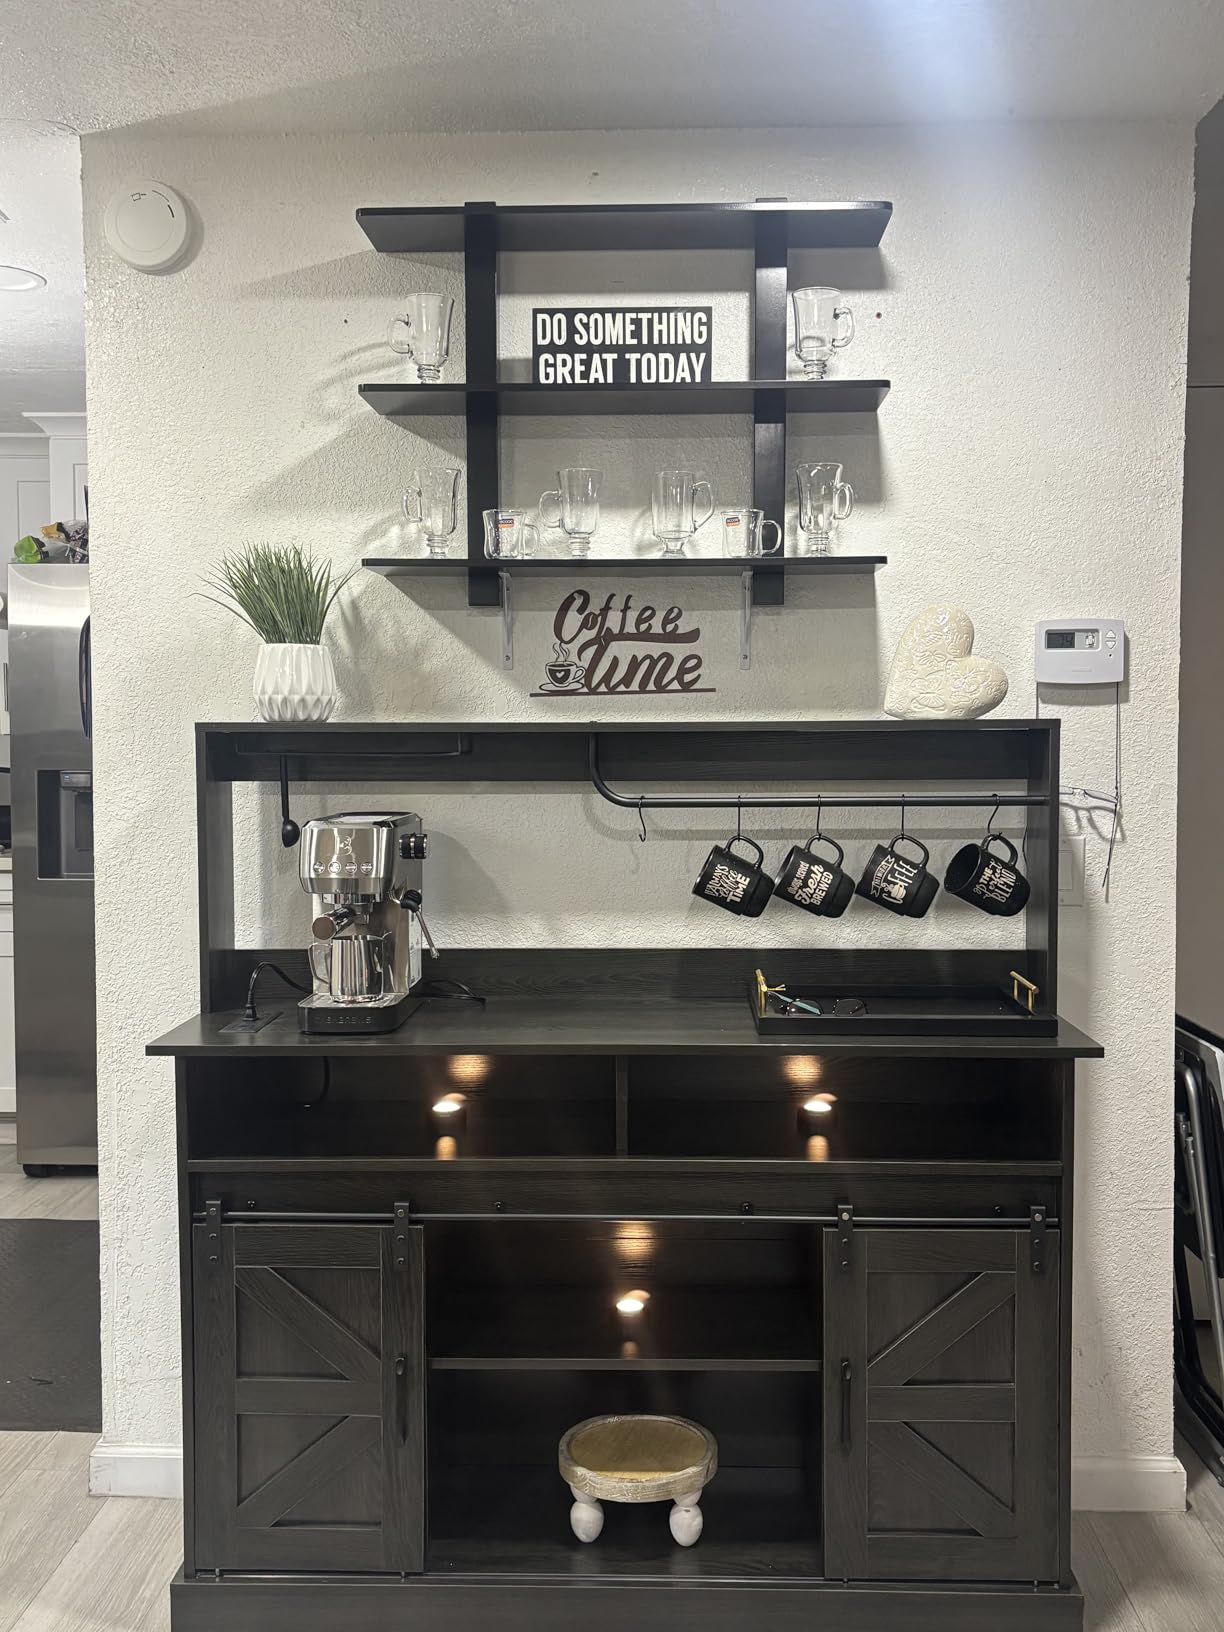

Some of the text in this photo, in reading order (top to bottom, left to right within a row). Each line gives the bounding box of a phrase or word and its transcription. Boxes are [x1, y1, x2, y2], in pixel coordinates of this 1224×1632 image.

[536, 311, 708, 346] DO SOMETHING
[538, 352, 707, 384] GREAT TODAY
[553, 589, 684, 644] Coffee
[726, 873, 750, 903] TIME
[794, 864, 824, 905] Fresh
[811, 871, 834, 906] BREWED
[979, 867, 993, 885] THE
[992, 868, 1017, 903] BLEND
